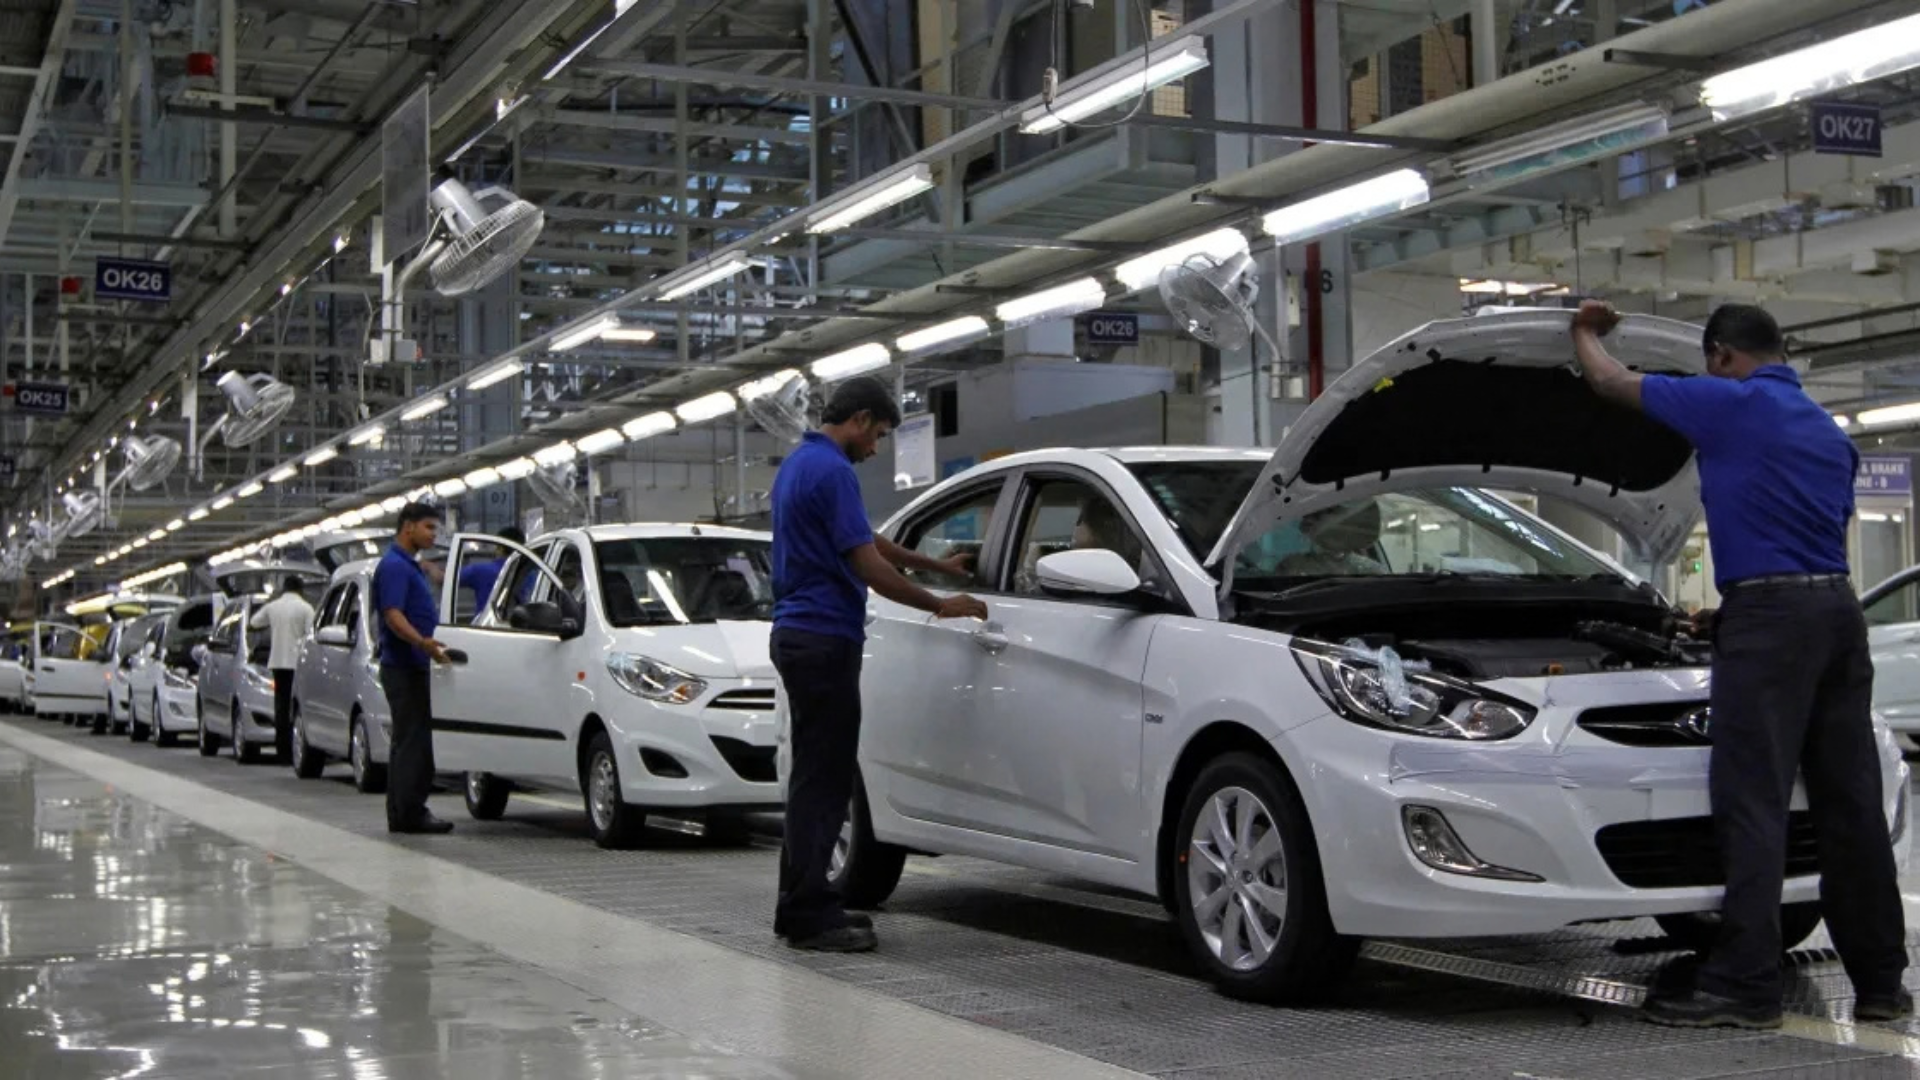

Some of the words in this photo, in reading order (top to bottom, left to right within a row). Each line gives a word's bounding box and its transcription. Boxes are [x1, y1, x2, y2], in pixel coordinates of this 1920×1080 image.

[1821, 114, 1875, 141] OK27
[103, 268, 162, 292] OK26
[1092, 320, 1134, 337] OK26
[20, 390, 62, 407] OK25
